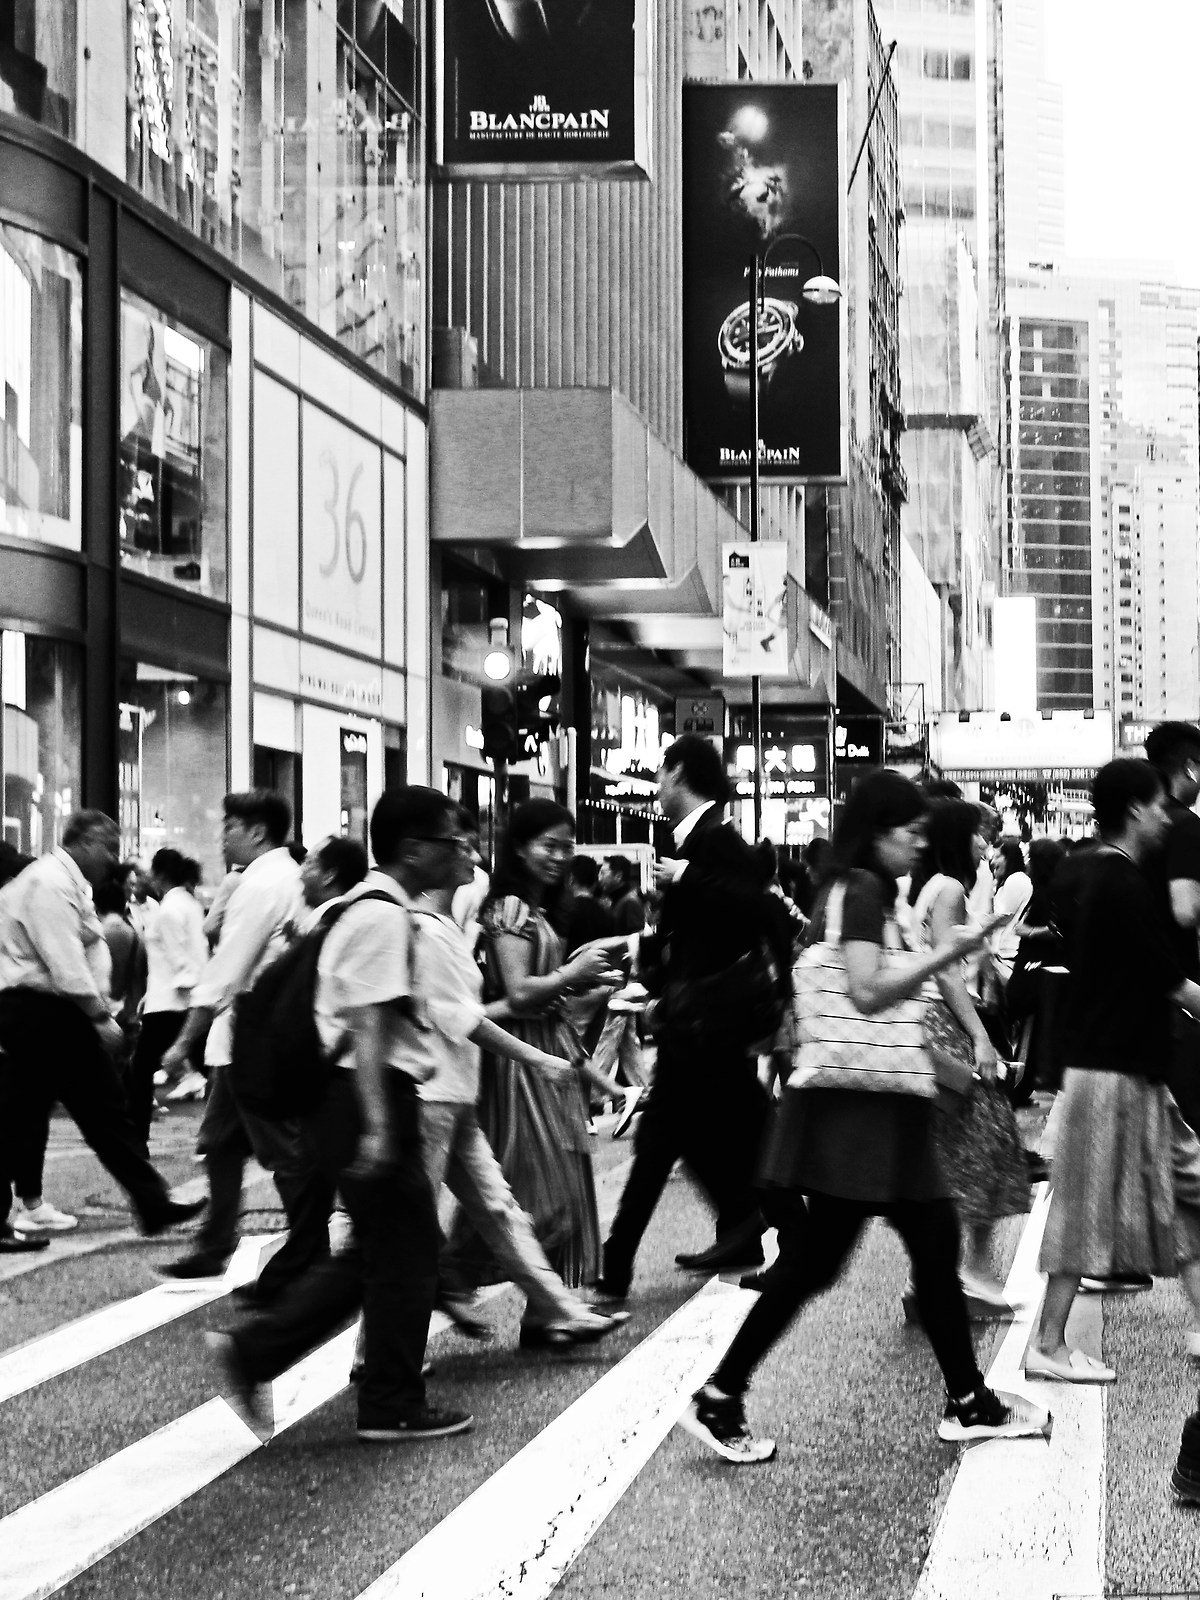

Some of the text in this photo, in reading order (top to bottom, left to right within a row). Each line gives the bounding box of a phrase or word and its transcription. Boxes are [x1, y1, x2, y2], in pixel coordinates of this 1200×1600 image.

[470, 109, 610, 131] BLANCPAIN
[719, 446, 800, 461] BLACPAIN
[318, 450, 368, 584] 36
